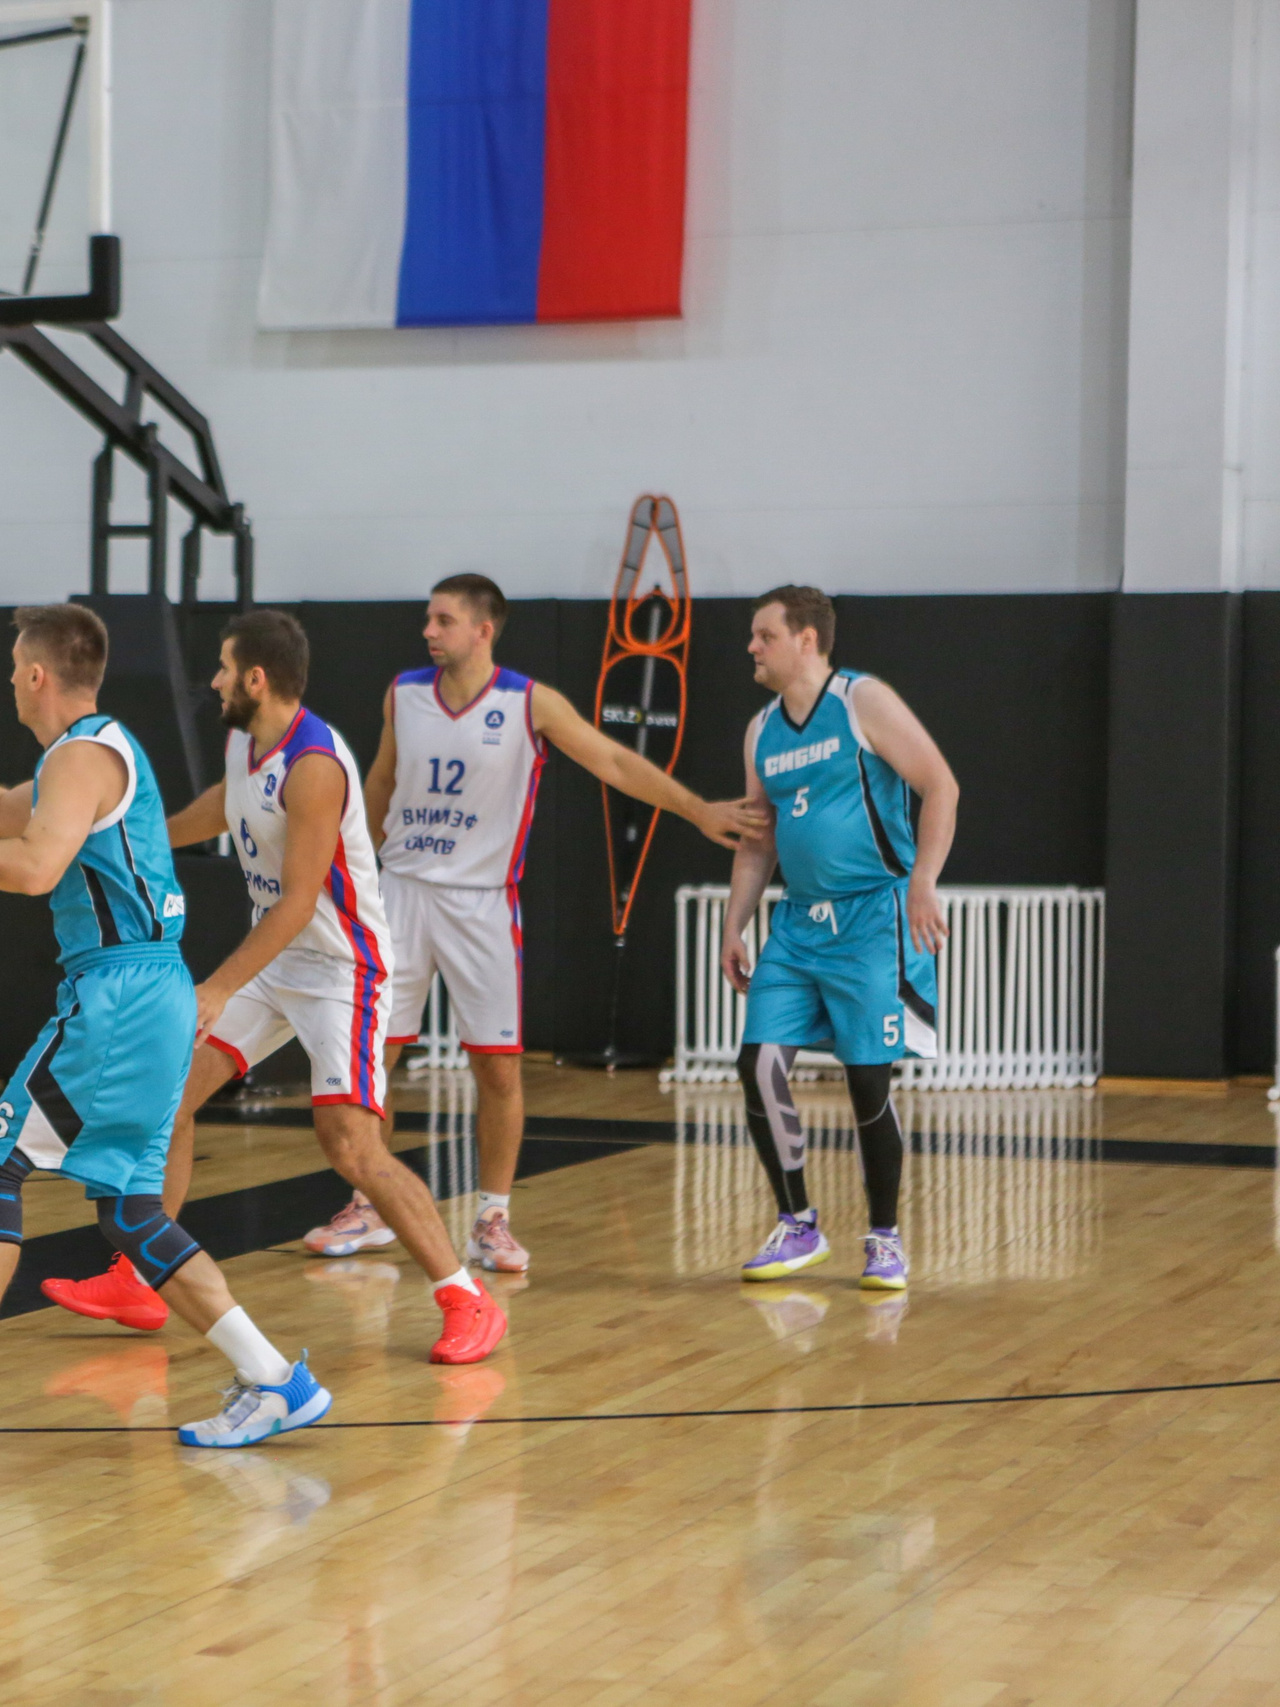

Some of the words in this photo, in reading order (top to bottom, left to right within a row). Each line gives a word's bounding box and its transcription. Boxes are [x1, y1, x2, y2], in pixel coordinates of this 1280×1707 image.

[765, 736, 840, 778] СИБУР
[427, 758, 465, 795] 12
[791, 786, 810, 818] 5
[239, 818, 258, 859] 6
[882, 1013, 901, 1047] 5
